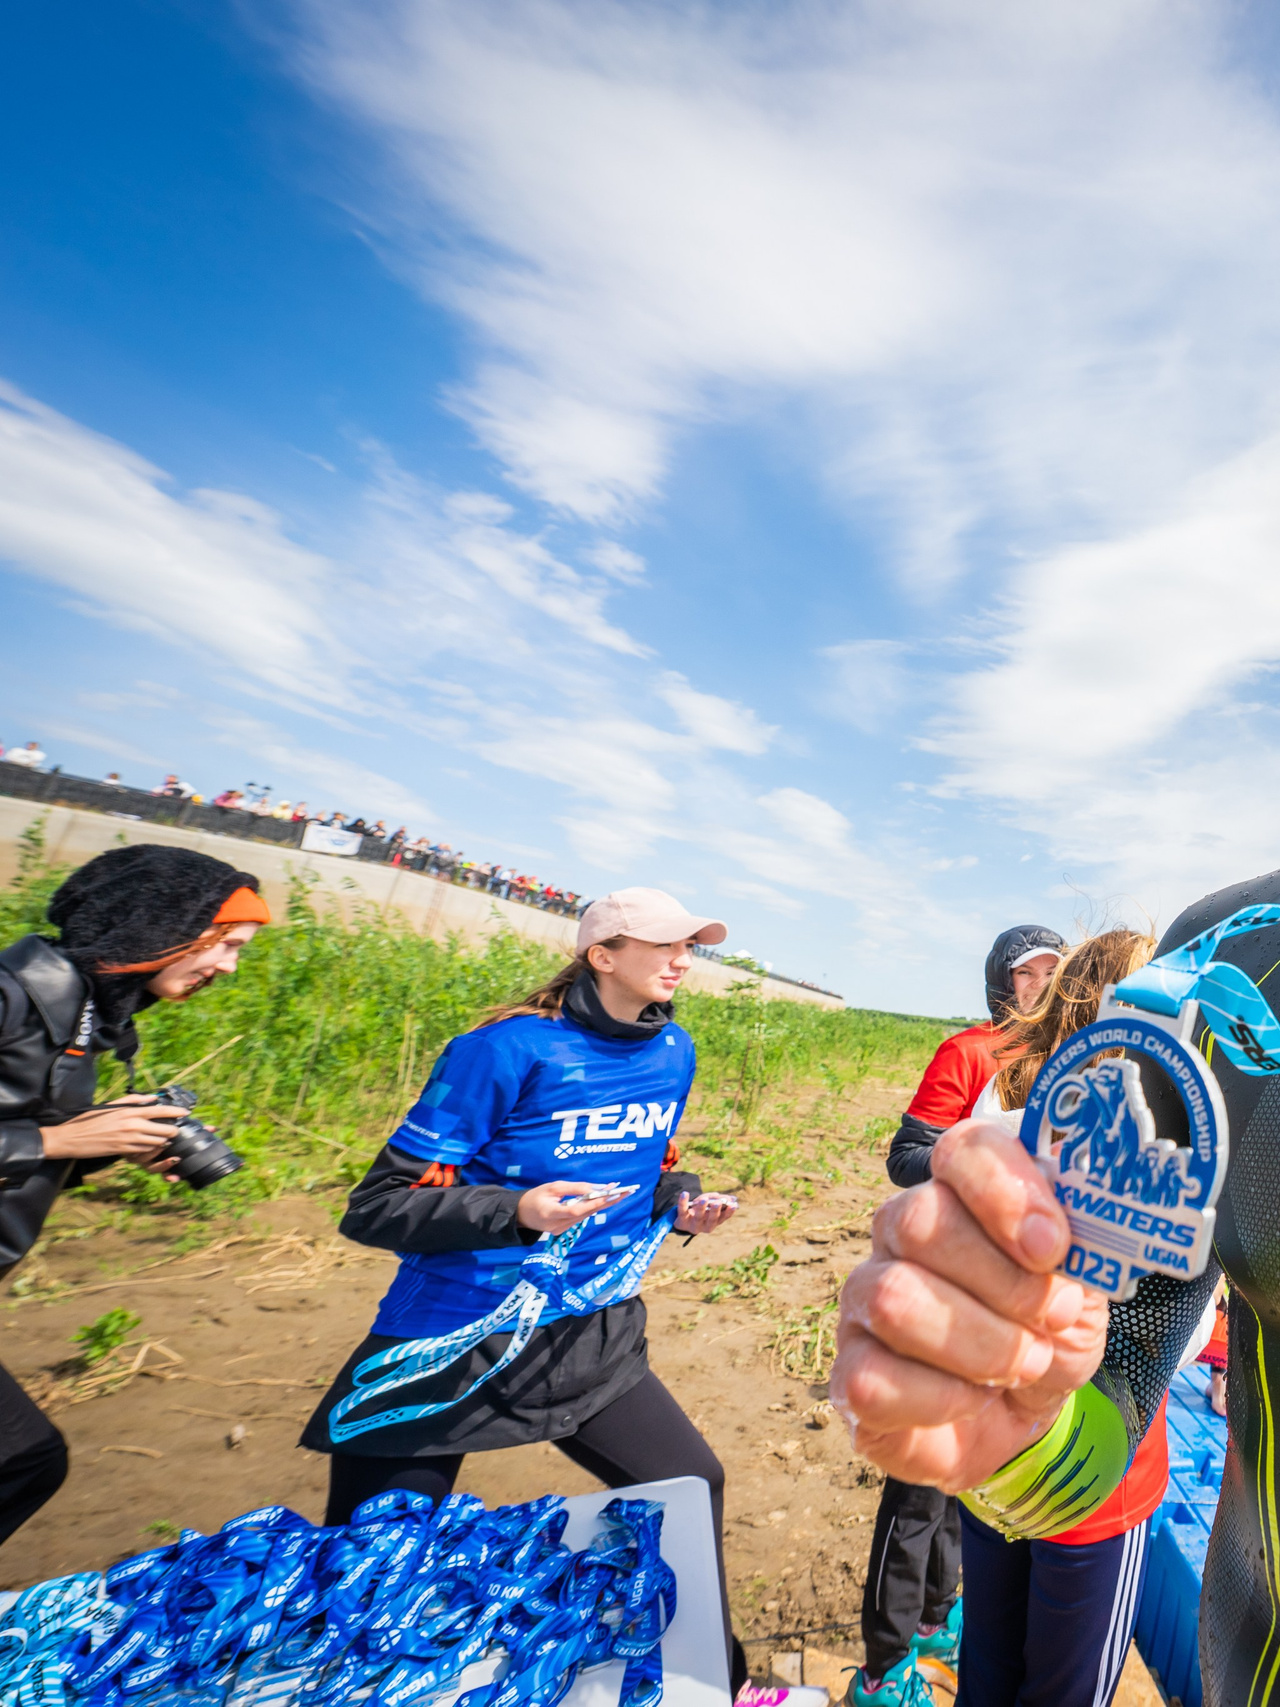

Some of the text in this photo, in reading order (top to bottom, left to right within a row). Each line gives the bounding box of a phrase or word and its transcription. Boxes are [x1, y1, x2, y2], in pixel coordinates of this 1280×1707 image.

[1028, 1028, 1212, 1163] X-WATERS WORLD CHAMPIONSHIP
[551, 1101, 677, 1142] TEAM
[1056, 1244, 1122, 1292] 023
[1143, 1243, 1189, 1274] UGRA
[562, 1290, 587, 1311] UGRA
[487, 1583, 526, 1599] 10 KM
[630, 1571, 647, 1607] UGRA
[500, 1623, 519, 1638] RA
[384, 1669, 435, 1706] UGRA
